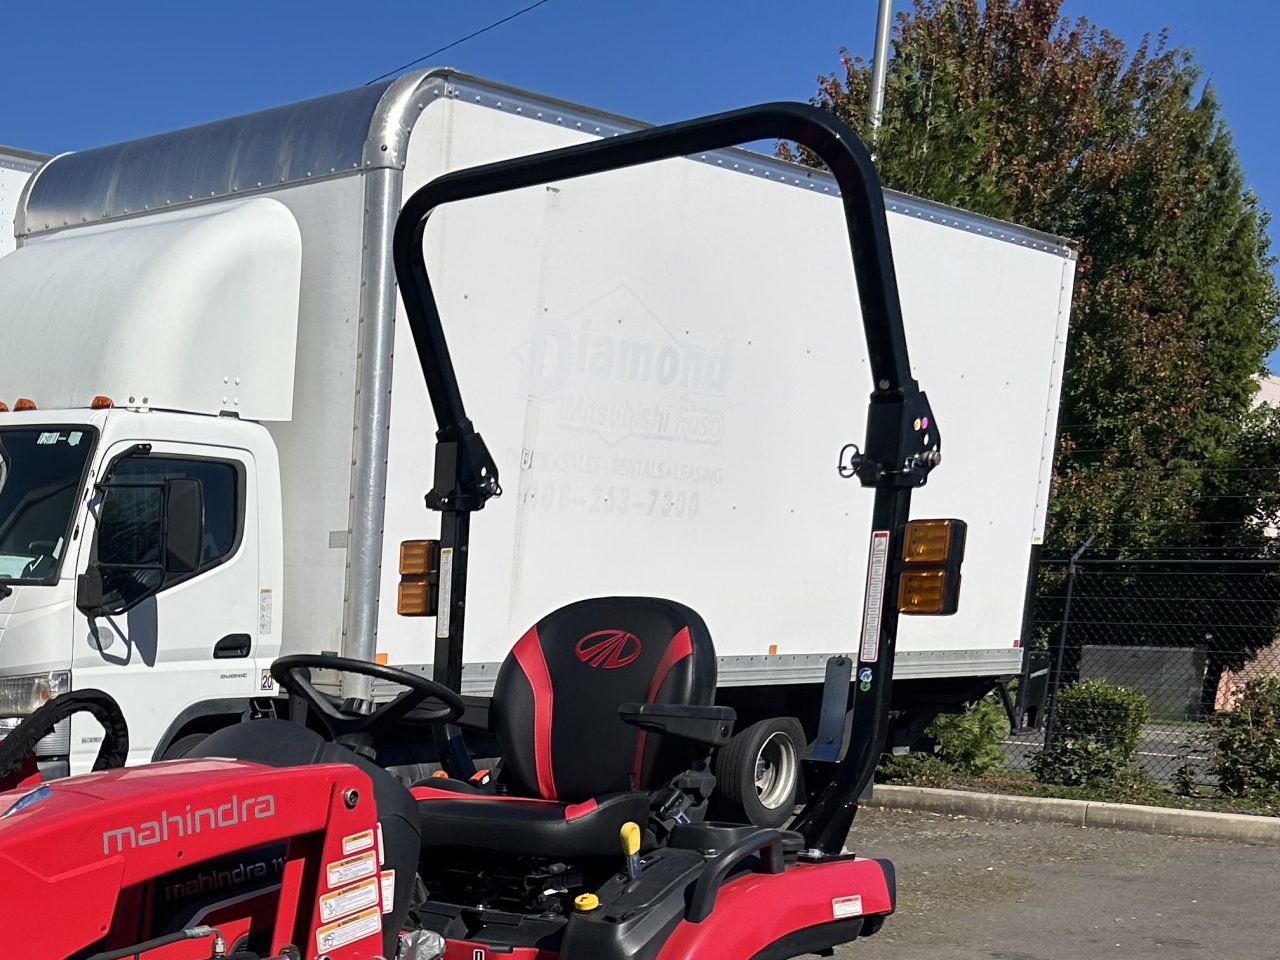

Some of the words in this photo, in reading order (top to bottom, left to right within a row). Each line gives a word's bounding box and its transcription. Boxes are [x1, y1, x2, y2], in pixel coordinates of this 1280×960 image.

[523, 315, 734, 397] Diamond
[563, 392, 671, 432] Mitsubishi
[676, 405, 723, 440] Fuso
[610, 457, 666, 480] RENTALS
[673, 464, 723, 485] LEASING
[103, 794, 275, 855] mahindra
[164, 862, 267, 902] mahindra
[271, 855, 287, 873] 11
